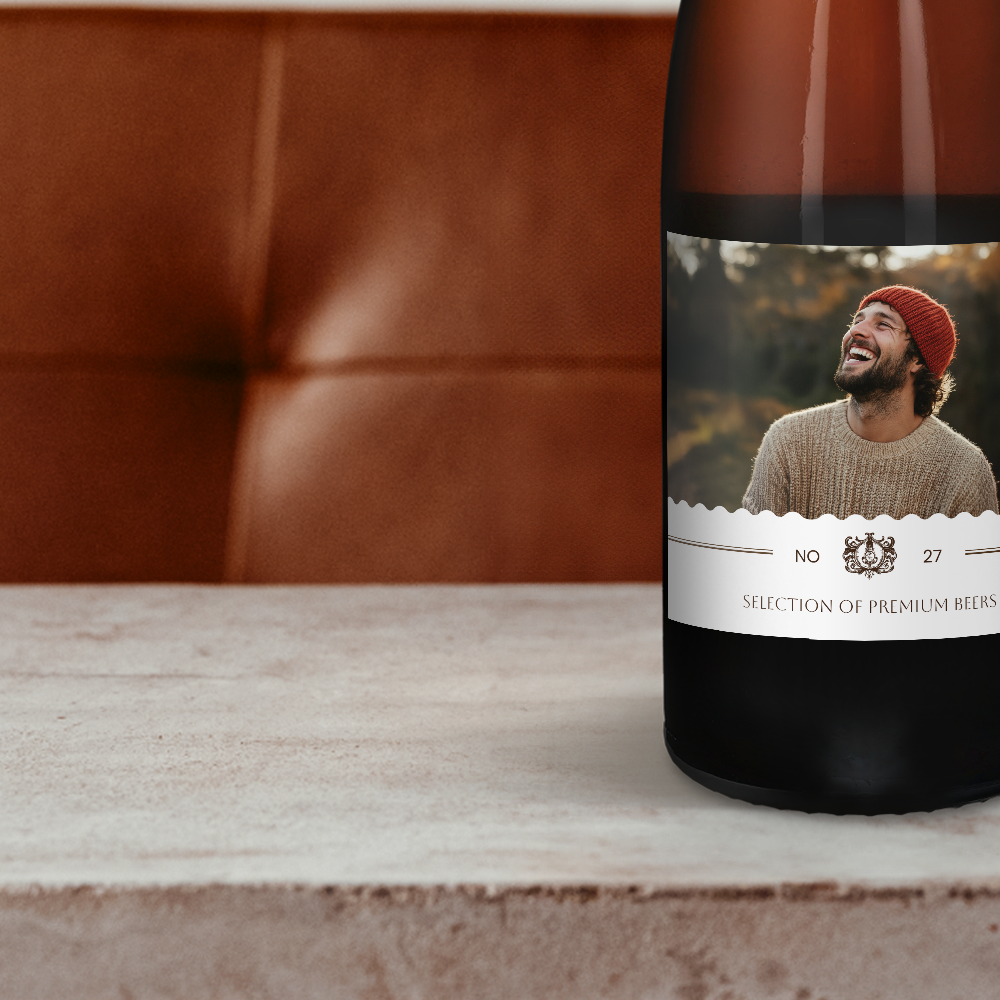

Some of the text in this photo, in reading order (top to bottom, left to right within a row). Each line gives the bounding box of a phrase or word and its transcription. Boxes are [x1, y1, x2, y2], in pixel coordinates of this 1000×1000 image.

[795, 549, 942, 564] NO 27
[743, 593, 997, 614] SELECTION OF PREMIUM BEERS
